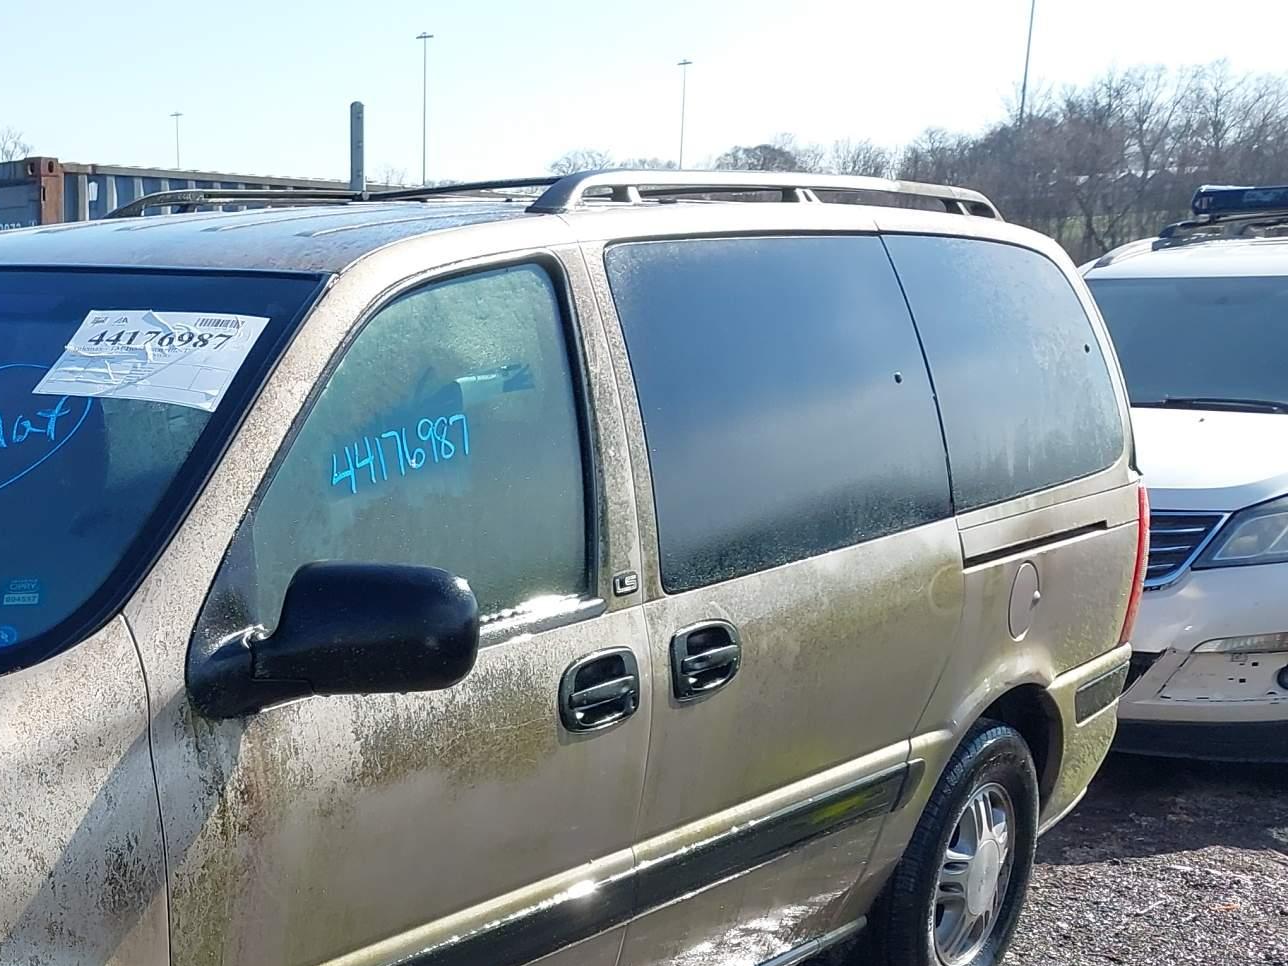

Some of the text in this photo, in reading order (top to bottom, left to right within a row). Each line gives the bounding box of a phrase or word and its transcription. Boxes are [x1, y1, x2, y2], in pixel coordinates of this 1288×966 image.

[88, 329, 232, 350] 44176987
[331, 414, 469, 493] 44176987
[615, 574, 637, 594] LS
